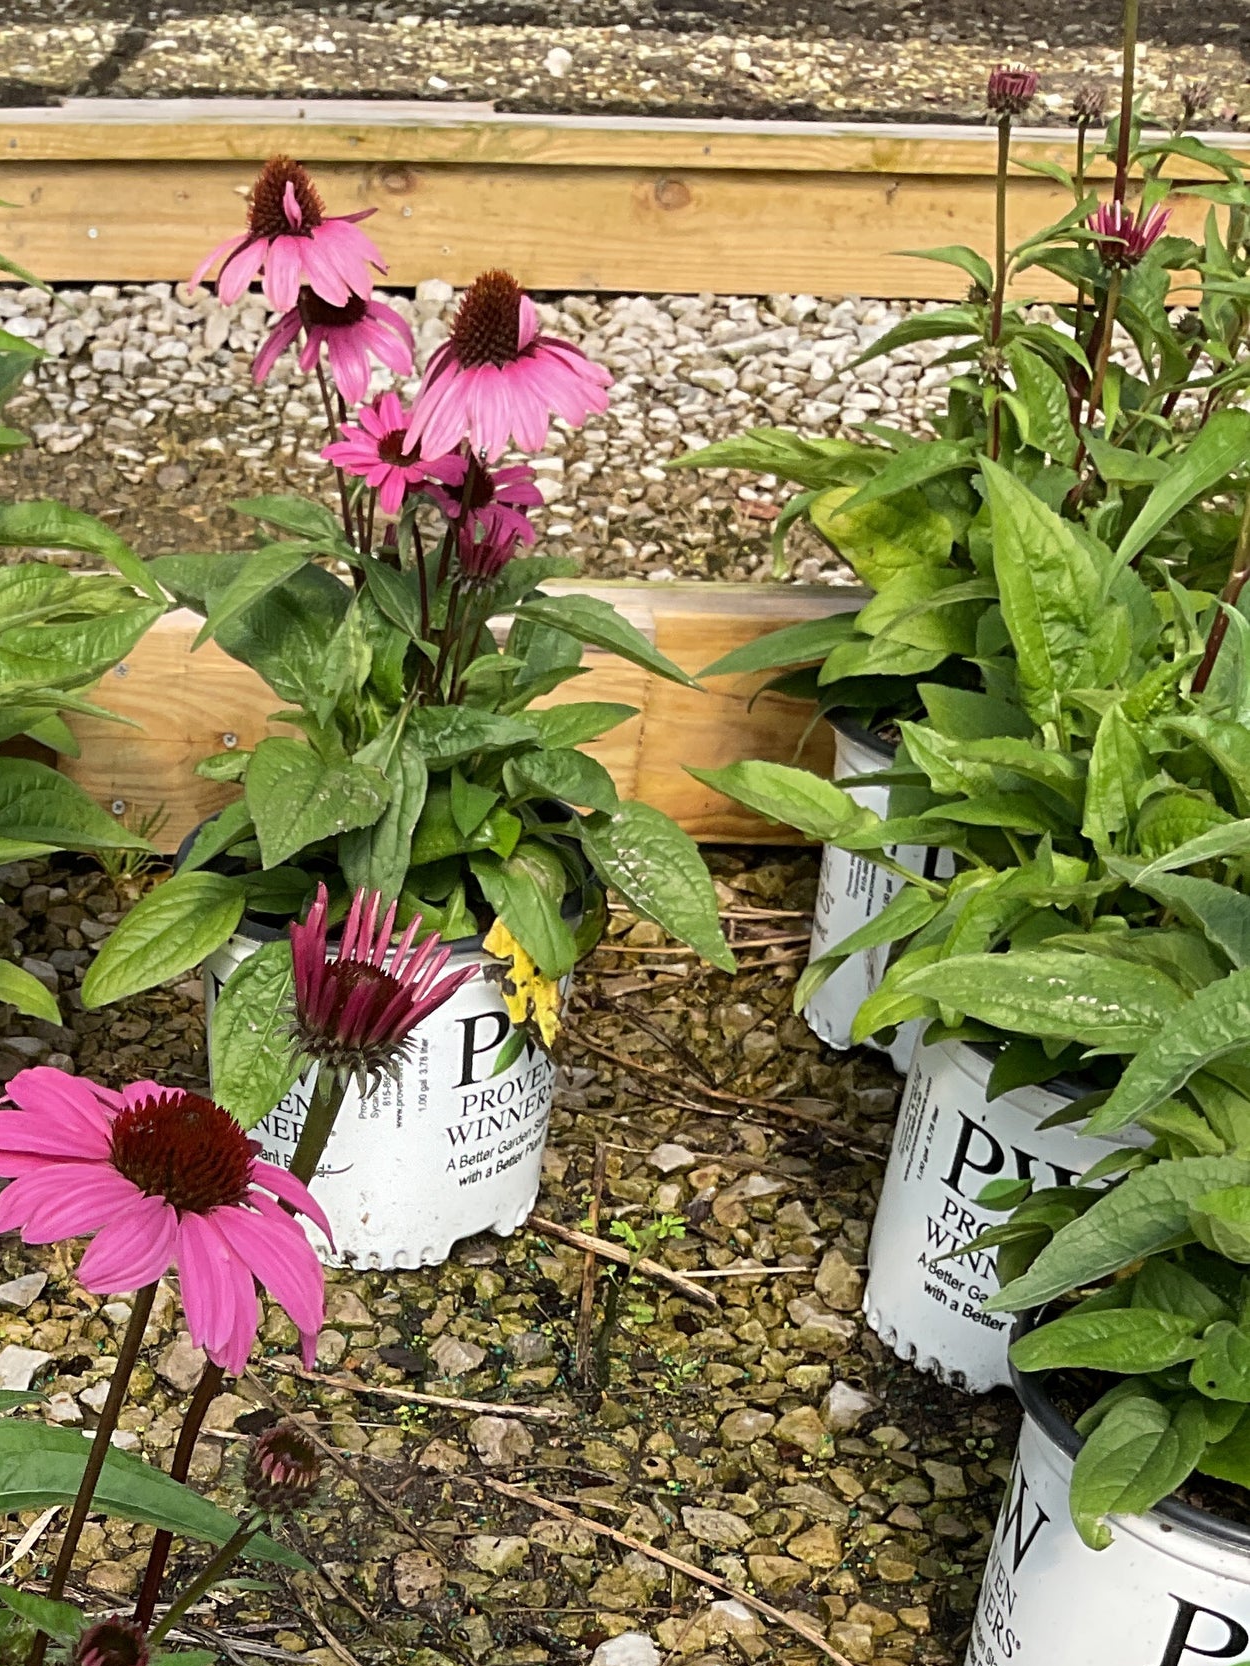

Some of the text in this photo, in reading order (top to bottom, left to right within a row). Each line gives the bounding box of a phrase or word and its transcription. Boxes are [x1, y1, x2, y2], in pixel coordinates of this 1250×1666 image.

[418, 1056, 428, 1075] 3.78
[419, 1080, 429, 1092] gal
[418, 1094, 427, 1112] 1.00
[446, 1158, 456, 1173] A
[459, 1147, 495, 1168] Better
[498, 1130, 532, 1154] Garden
[458, 1169, 482, 1187] with
[485, 1165, 492, 1178] a
[495, 1150, 523, 1175] Better
[926, 1215, 998, 1281] WINN
[928, 1261, 965, 1291] Better
[924, 1280, 947, 1305] with
[949, 1300, 958, 1312] a
[962, 1304, 1007, 1332] Better
